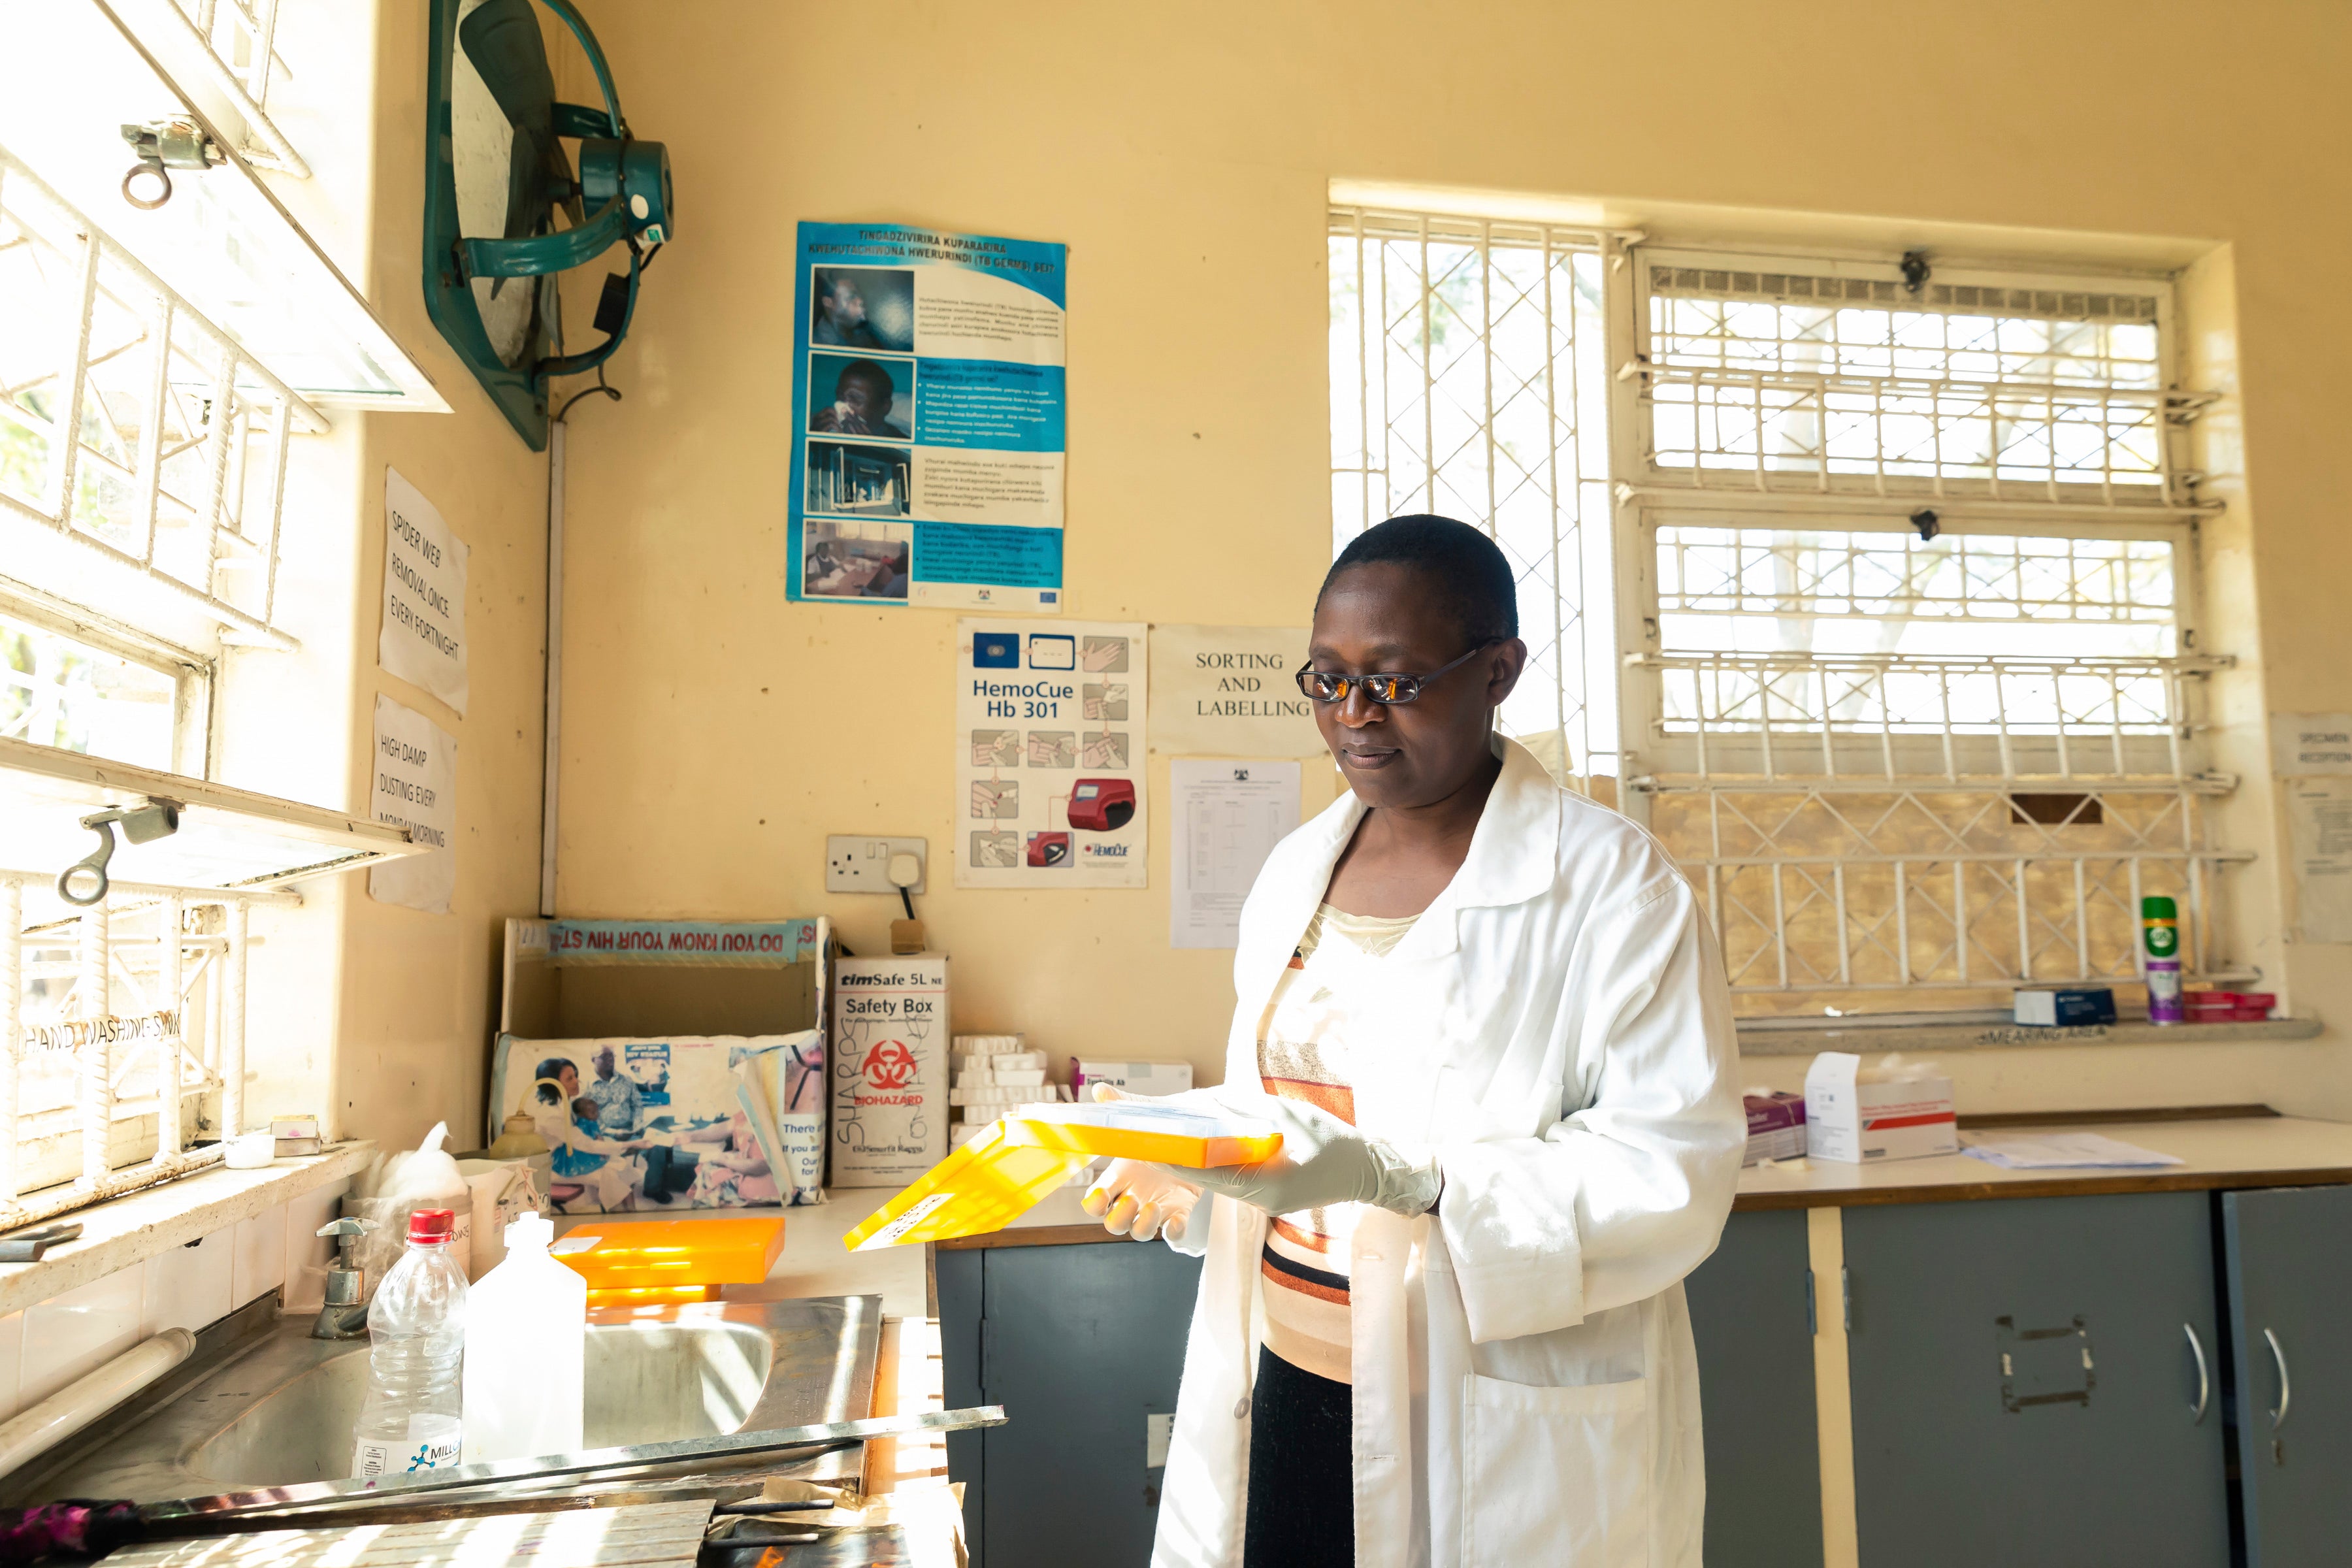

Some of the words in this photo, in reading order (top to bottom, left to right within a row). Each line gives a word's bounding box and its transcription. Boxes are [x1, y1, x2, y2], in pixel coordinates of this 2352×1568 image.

[944, 237, 1007, 253] KUPARARIRA
[908, 248, 972, 263] HWERURINDI
[392, 510, 421, 552] SPIDER
[422, 537, 441, 568] WEB
[392, 552, 427, 601] REMOVAL
[428, 587, 449, 619] ONCE
[391, 595, 414, 630] EVERY
[416, 615, 459, 661] FORTNIGHT
[1196, 653, 1282, 670] SORTING
[973, 679, 1073, 698] HemoCue
[1218, 677, 1261, 692] AND
[988, 700, 1015, 717] Hb
[1024, 702, 1057, 718] 301
[1198, 700, 1309, 717] LABELLING
[381, 734, 400, 759] HIGH
[402, 743, 427, 768] DAMP
[380, 773, 414, 802] DUSTING
[416, 786, 436, 809] EVERY
[413, 823, 445, 847] MORNING
[587, 930, 614, 950] HIV
[617, 931, 664, 951] YOUR
[668, 932, 717, 951] KNOW
[721, 933, 755, 952] YOU
[759, 933, 783, 953] DO
[841, 973, 906, 987] timSafe
[911, 973, 927, 985] 5L
[846, 998, 897, 1017] Safety
[904, 998, 933, 1013] Box
[24, 1024, 76, 1054] HAND
[82, 1017, 151, 1046] WASHING
[837, 1017, 870, 1147] SHARPS
[854, 1094, 923, 1106] BIOHAZARD
[784, 1124, 815, 1133] There
[792, 1145, 808, 1154] you
